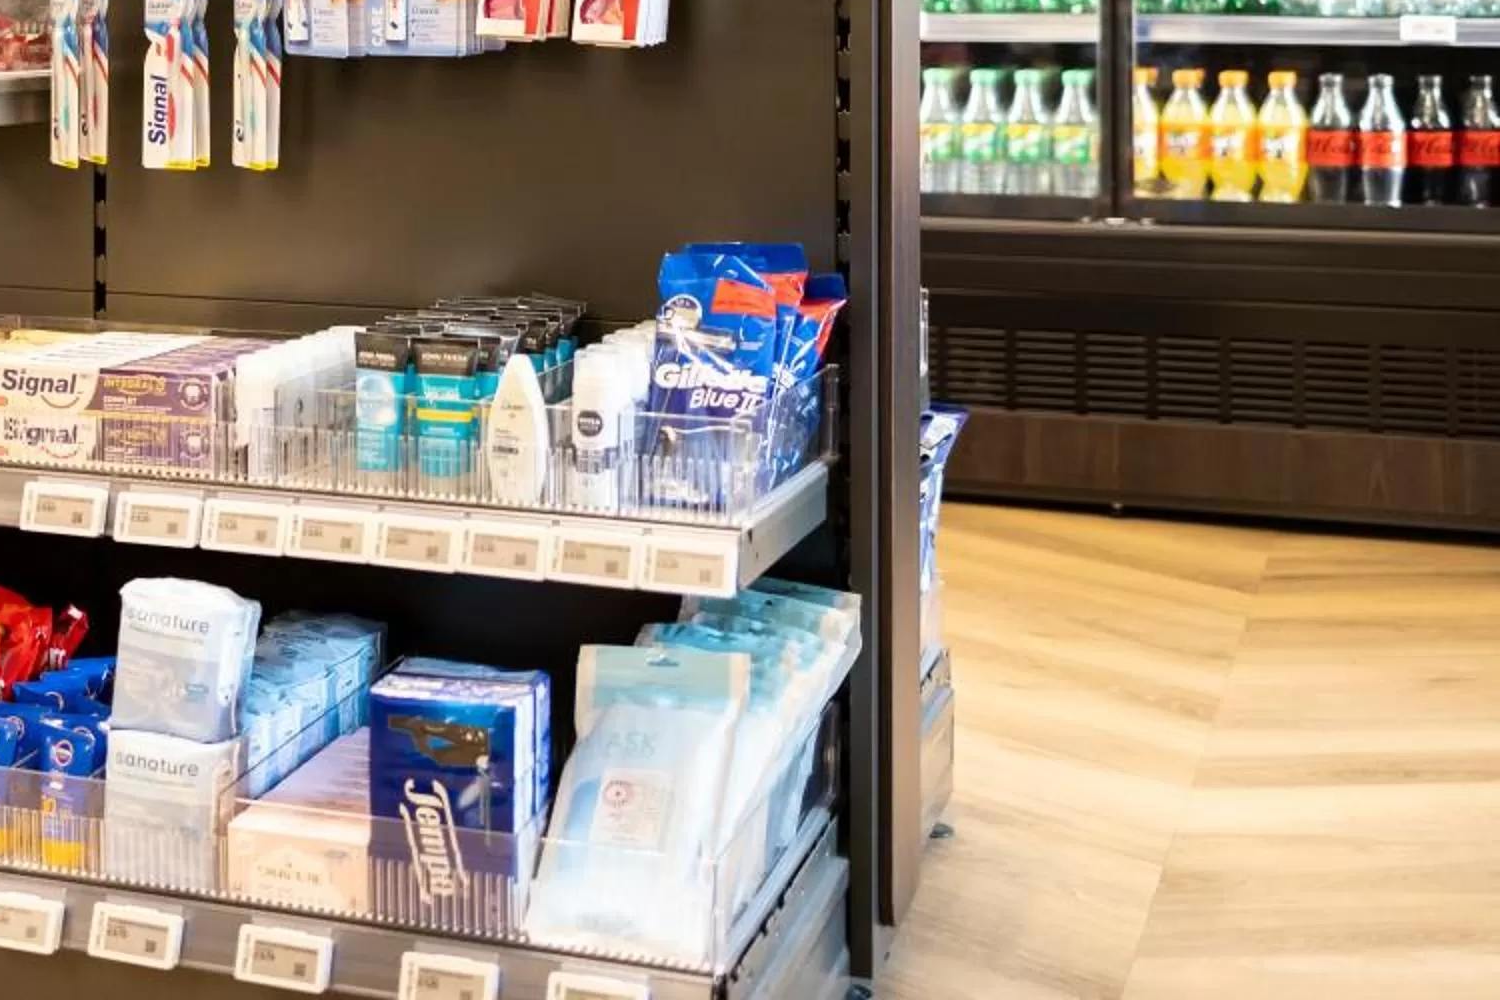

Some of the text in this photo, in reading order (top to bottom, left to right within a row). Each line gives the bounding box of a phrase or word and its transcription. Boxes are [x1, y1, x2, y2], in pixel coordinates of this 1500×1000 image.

[149, 74, 168, 145] Signal
[1, 368, 78, 396] Signal
[689, 385, 739, 410] Blue
[115, 748, 200, 778] sanature
